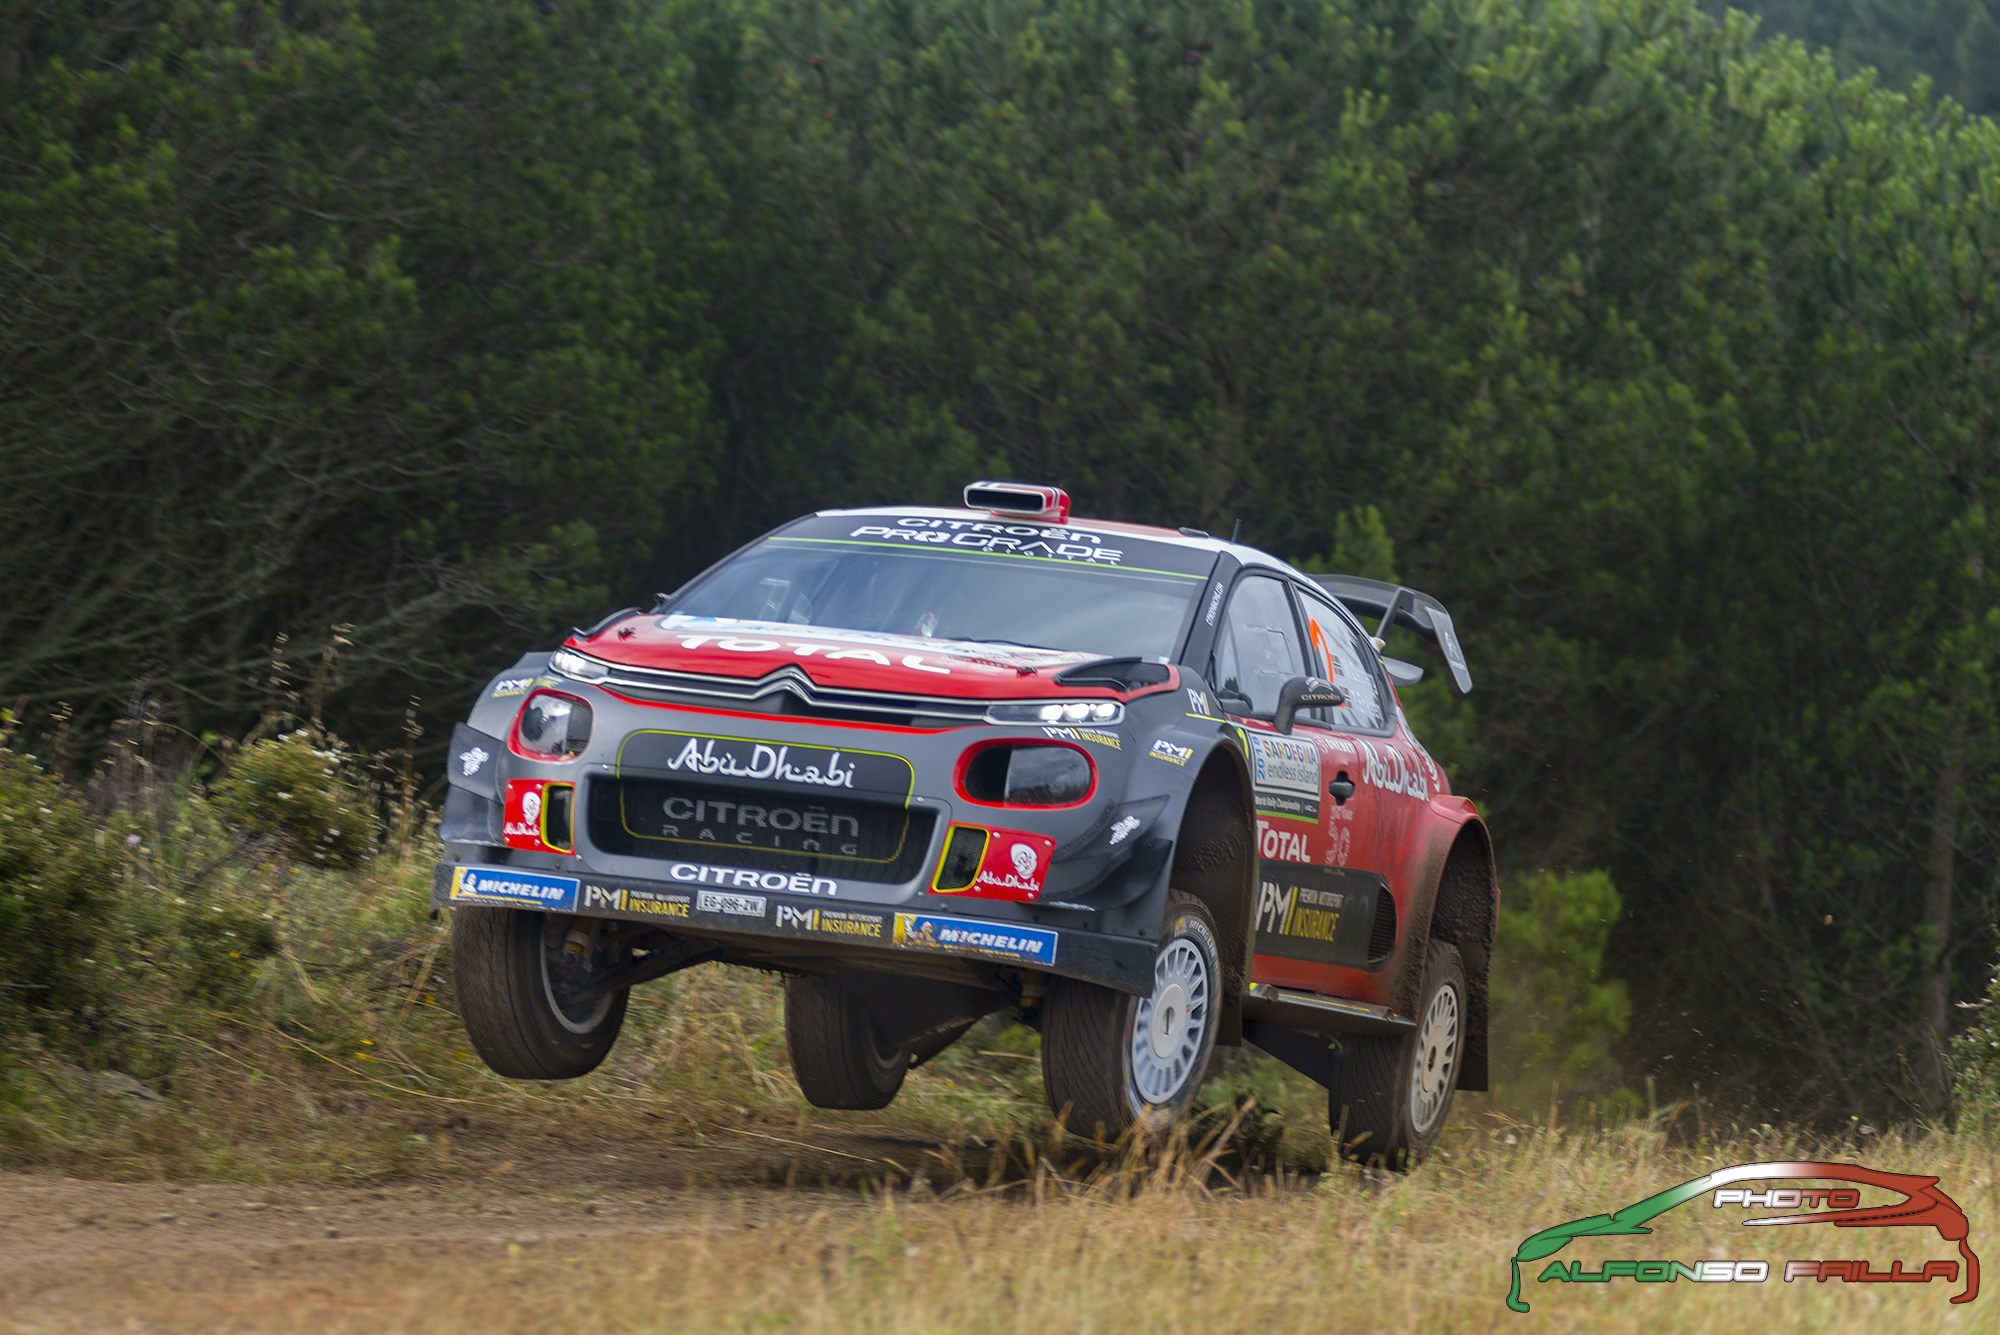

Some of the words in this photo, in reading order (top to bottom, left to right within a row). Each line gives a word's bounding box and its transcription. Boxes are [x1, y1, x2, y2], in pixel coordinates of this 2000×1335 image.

[675, 634, 951, 674] TOTAL
[1080, 732, 1122, 750] INSURANCE
[1262, 740, 1317, 765] SARDEGNA
[1252, 736, 1266, 780] 2018
[1268, 760, 1297, 781] endless
[662, 825, 858, 855] RACING
[1257, 820, 1311, 863] TOTAL
[477, 879, 565, 900] MICHELIN
[629, 898, 690, 918] INSURANCE
[821, 918, 882, 938] INSURANCE
[938, 928, 1043, 953] MICHELIN
[1188, 919, 1217, 959] MICHELIN
